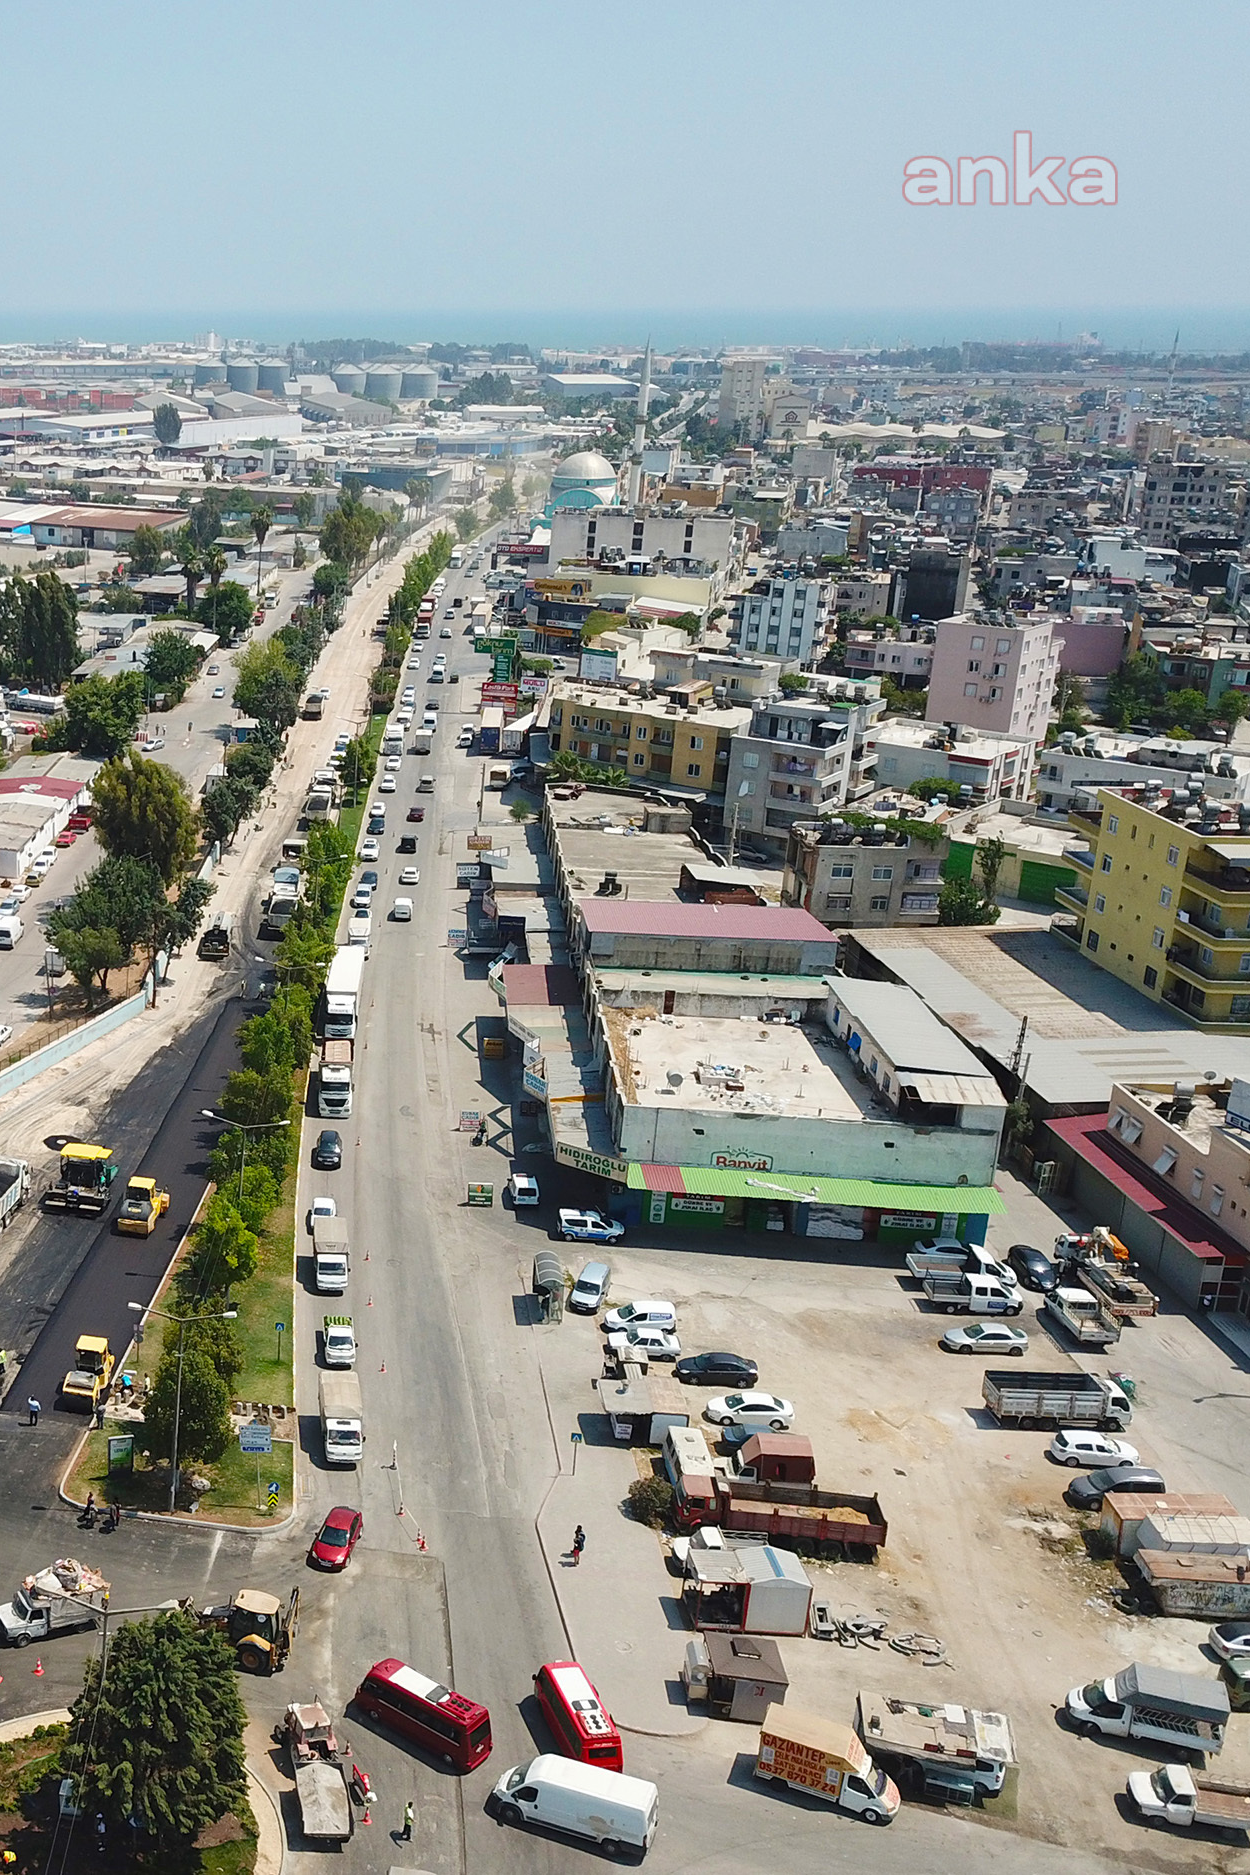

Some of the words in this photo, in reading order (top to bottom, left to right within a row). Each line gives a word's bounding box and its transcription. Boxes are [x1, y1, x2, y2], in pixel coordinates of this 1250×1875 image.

[559, 1146, 626, 1173] HIDIROĞLU
[573, 1159, 612, 1177] TARIM
[759, 1761, 785, 1776] 0537
[786, 1770, 807, 1785] 870
[809, 1778, 821, 1789] 37
[821, 1782, 836, 1795] 24
